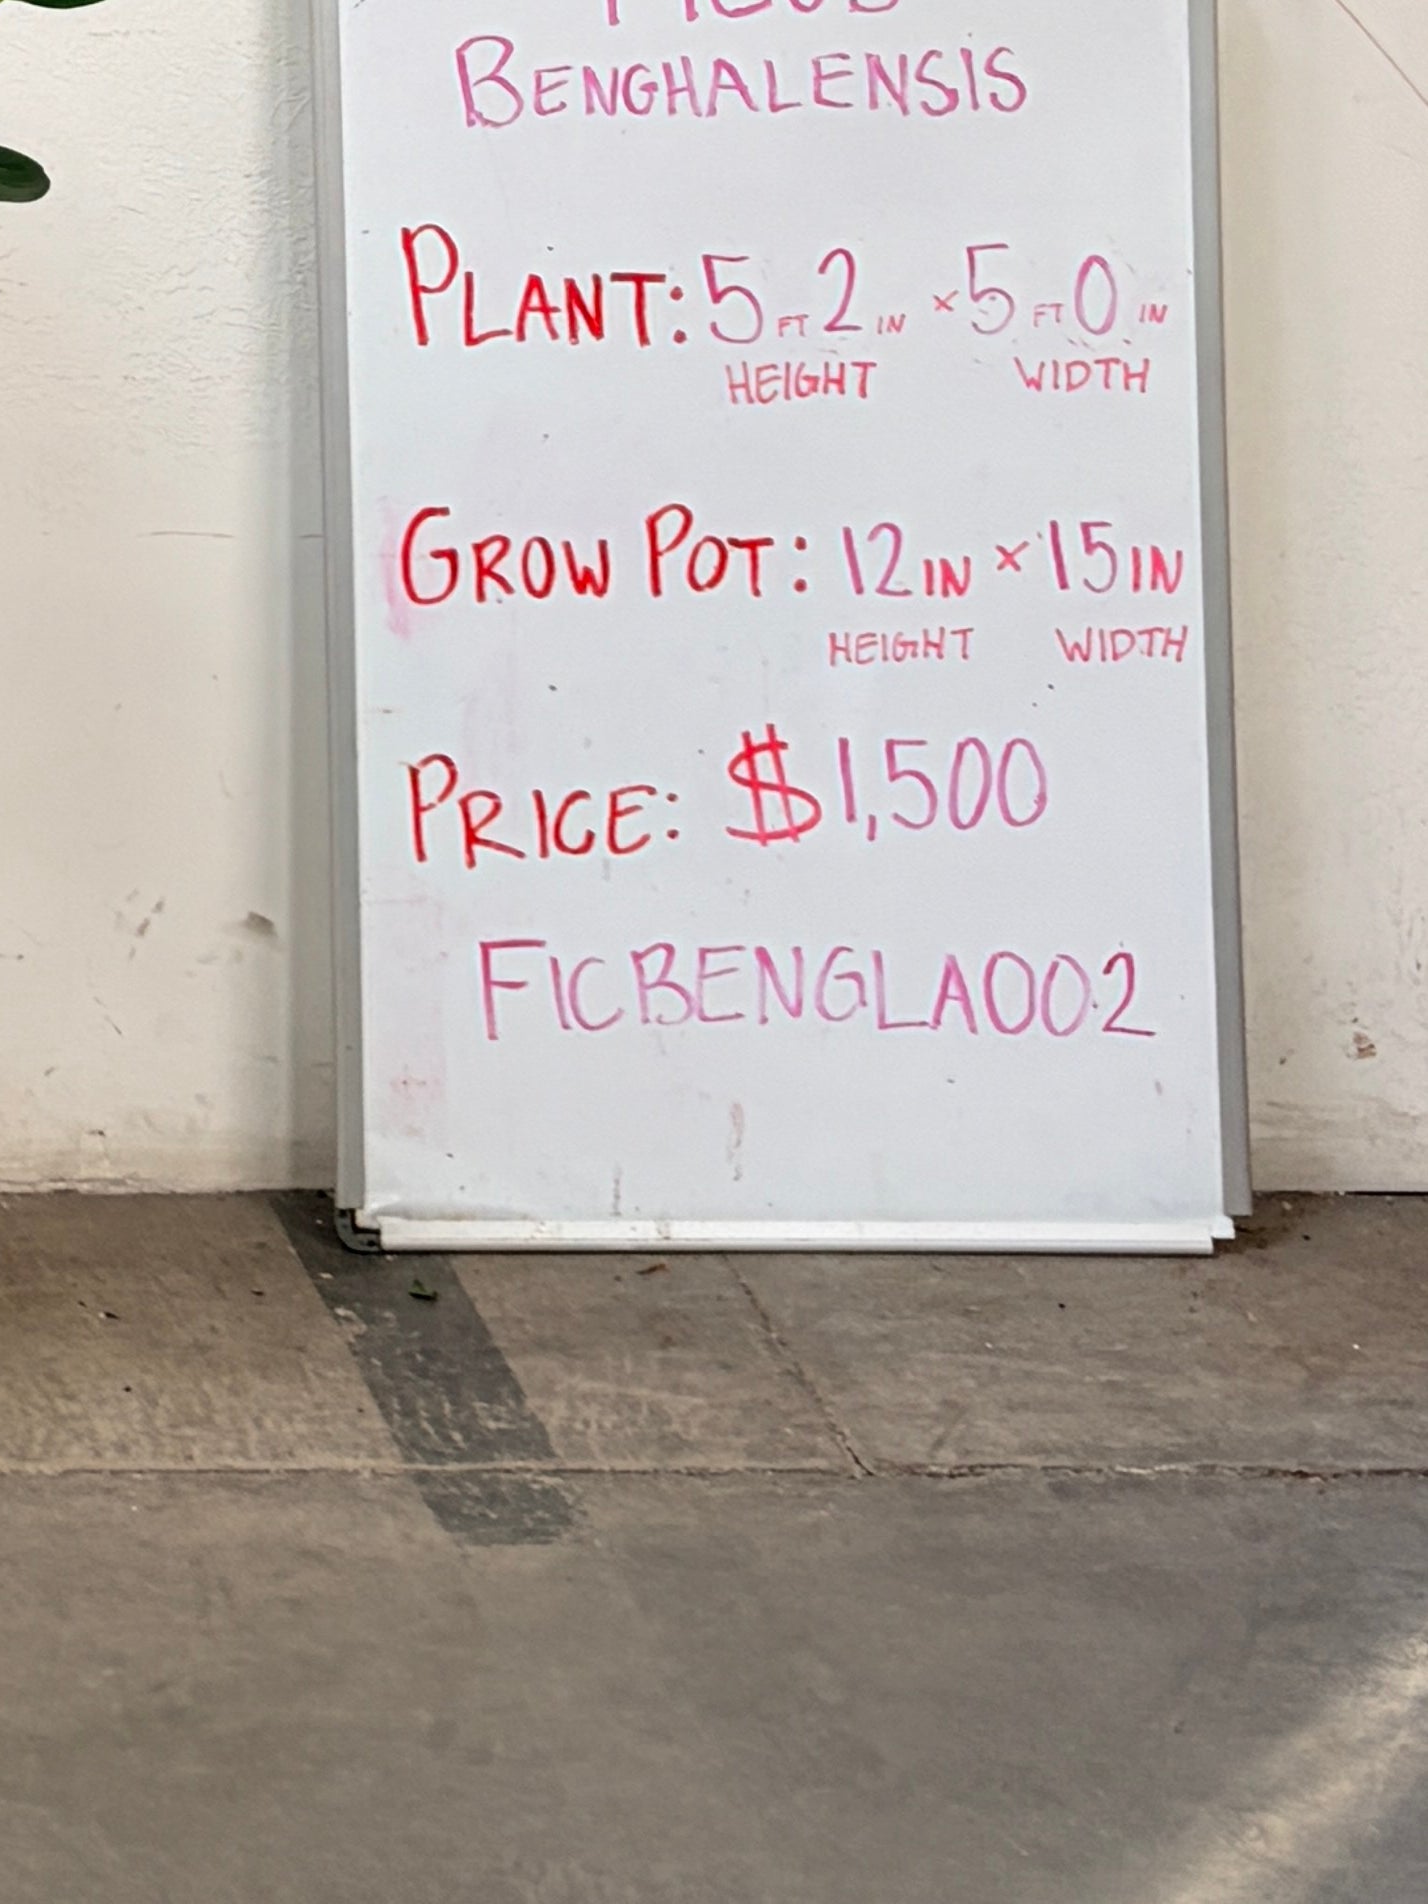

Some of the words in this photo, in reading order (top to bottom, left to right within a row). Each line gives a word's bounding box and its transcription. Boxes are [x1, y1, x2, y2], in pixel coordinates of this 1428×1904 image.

[452, 34, 1029, 130] BENGHALENSIS
[398, 222, 688, 350] PLANT:
[724, 358, 878, 407] HEIGHT
[1012, 355, 1152, 395] WIDTH
[400, 504, 613, 604] GROW
[642, 501, 810, 601] POT:
[826, 626, 973, 667] HEIGHT
[1054, 624, 1190, 665] WIDTH
[405, 752, 680, 872] PRICE:
[723, 721, 1050, 850] $1,500
[476, 937, 1154, 1043] FICBENGLA002
